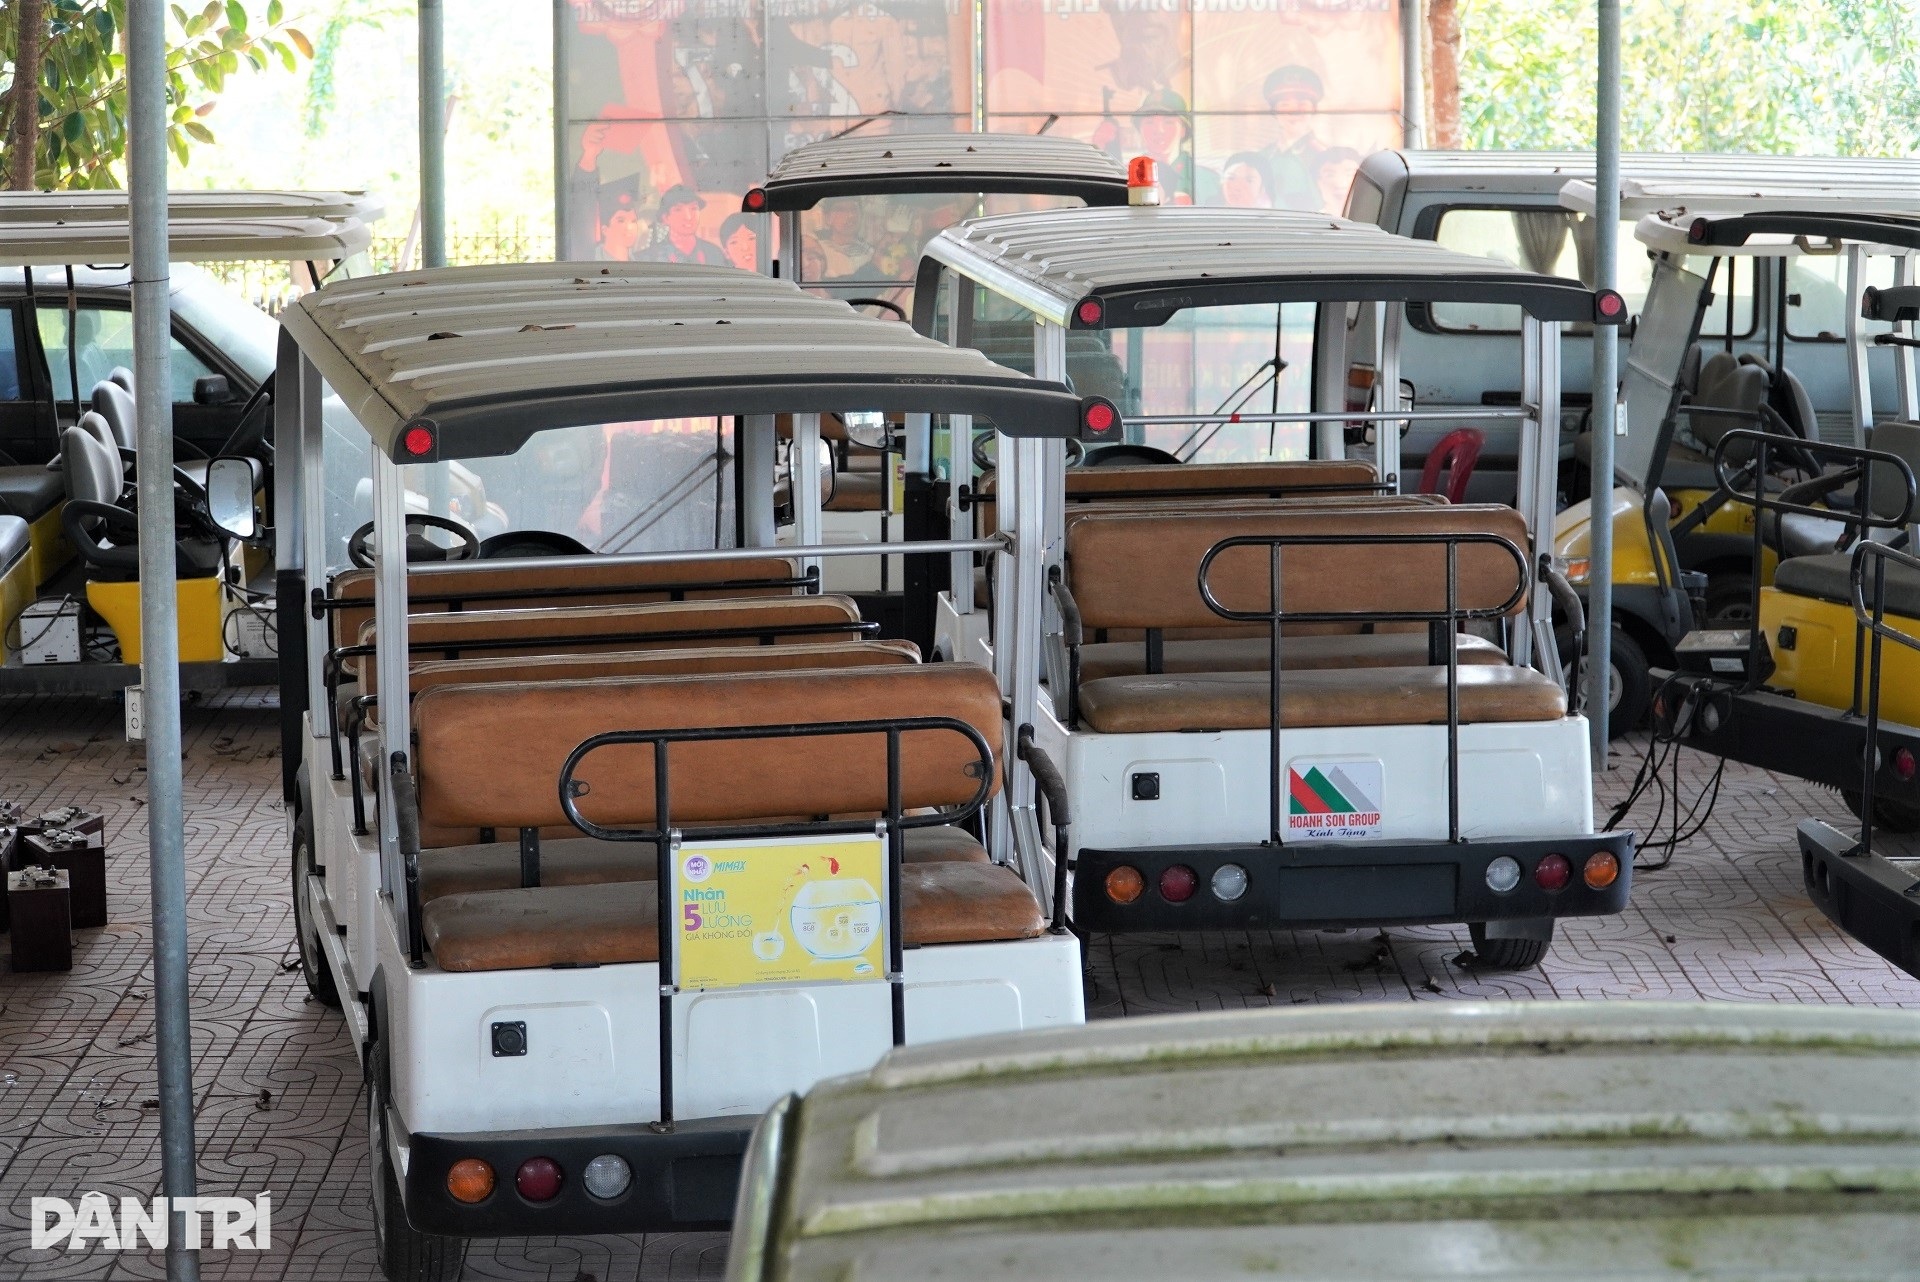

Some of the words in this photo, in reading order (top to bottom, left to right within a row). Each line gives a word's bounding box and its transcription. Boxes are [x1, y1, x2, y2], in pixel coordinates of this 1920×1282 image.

[1290, 815, 1322, 828] HOANH
[1325, 814, 1345, 827] SON
[1348, 813, 1380, 826] GROUP
[714, 861, 747, 873] MIMAX
[684, 887, 724, 901] Nhân
[684, 904, 702, 931] 5
